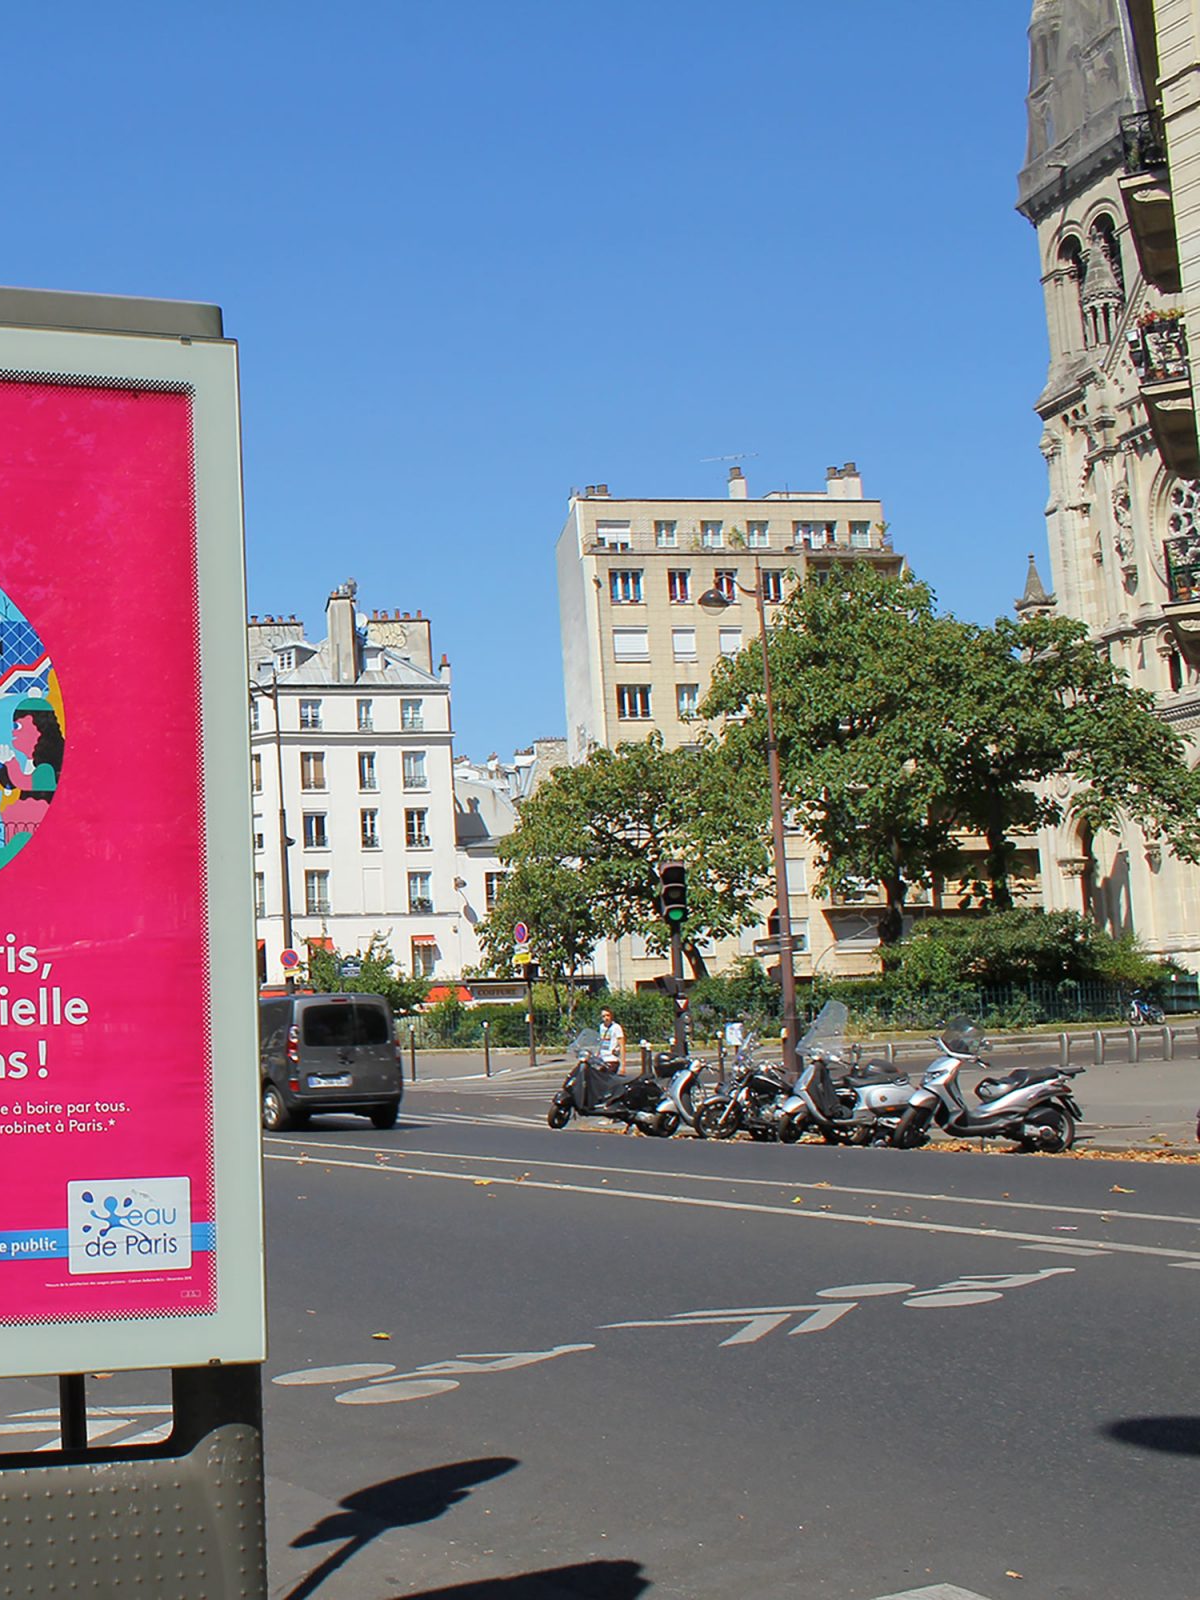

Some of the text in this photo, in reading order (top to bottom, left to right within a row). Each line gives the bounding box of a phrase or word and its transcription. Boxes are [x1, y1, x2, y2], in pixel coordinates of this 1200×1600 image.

[12, 1101, 22, 1115] à
[26, 1100, 63, 1115] boire
[66, 1103, 92, 1118] par
[93, 1101, 131, 1113] tous.
[0, 1120, 52, 1135] robinet
[54, 1119, 65, 1133] à
[126, 1205, 178, 1226] eau
[9, 1236, 57, 1257] public
[85, 1233, 178, 1257] de Paris
